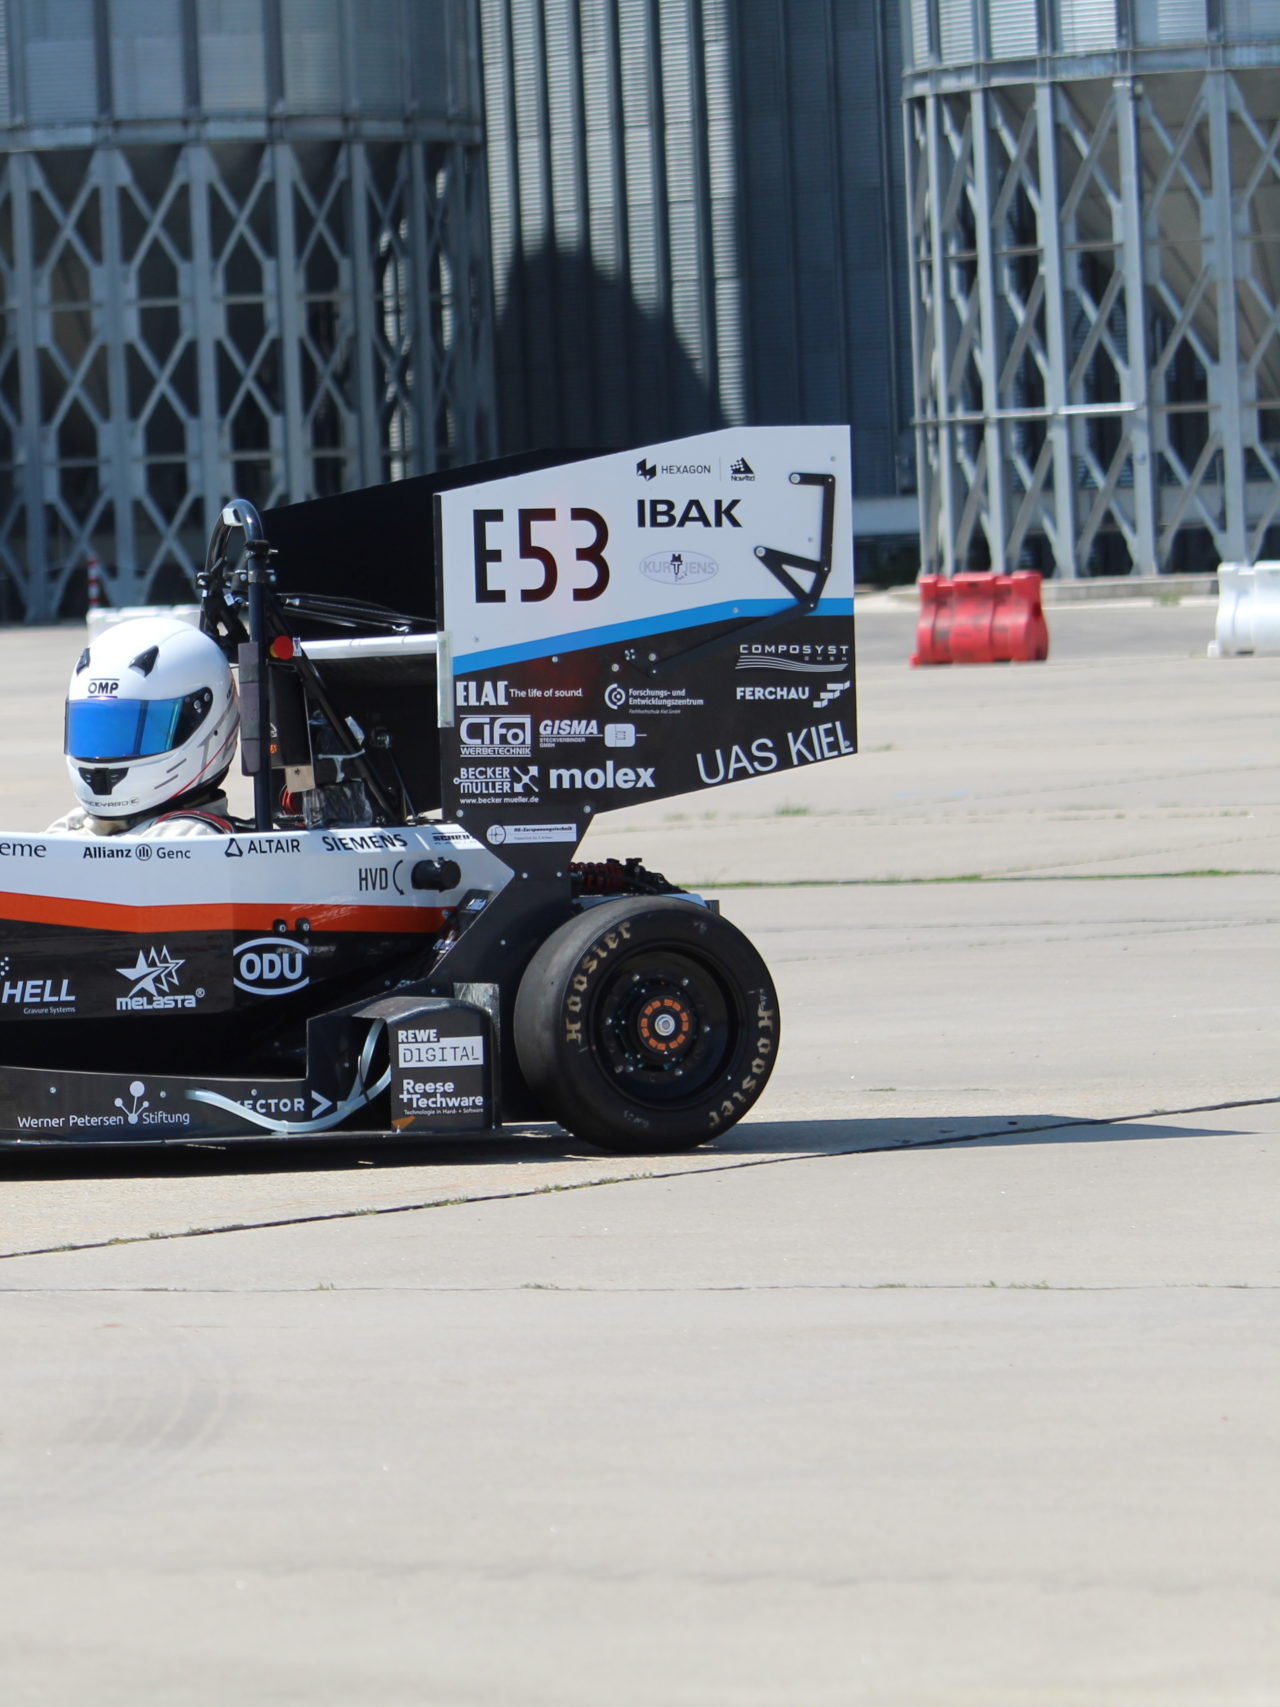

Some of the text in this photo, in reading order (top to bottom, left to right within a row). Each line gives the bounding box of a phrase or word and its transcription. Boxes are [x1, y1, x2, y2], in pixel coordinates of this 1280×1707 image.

[661, 465, 711, 475] HEXAGON
[637, 499, 742, 528] IBAK
[473, 507, 610, 604] E53
[739, 644, 849, 654] COMPOSYST
[88, 682, 119, 695] OMP
[456, 680, 508, 706] ELAC
[509, 688, 526, 698] The
[528, 688, 542, 698] life
[544, 688, 553, 697] of
[628, 688, 686, 698] Forschungs- und
[736, 687, 809, 700] FERCHAU
[628, 698, 704, 707] Entwicklungszentrum
[539, 720, 598, 735] GISMA
[460, 747, 532, 755] WERBETECHNIK
[696, 720, 854, 784] UAS KIEL
[460, 766, 511, 779] BECKER
[549, 760, 656, 790] molex
[247, 838, 301, 855] ALTAIR
[322, 834, 408, 852] SIEMENS
[83, 845, 191, 860] Allianz Genc
[358, 868, 388, 892] HVD
[240, 952, 303, 980] ODU
[566, 921, 631, 1044] Hoosier
[1, 978, 76, 1004] HELL
[50, 1006, 76, 1014] Systems
[398, 1029, 438, 1042] REWE
[403, 1045, 480, 1063] DIGITAL
[708, 1008, 774, 1128] Hoosier
[402, 1079, 455, 1094] Reese
[236, 1098, 305, 1113] ECTOR
[411, 1093, 484, 1108] Techware
[18, 1112, 190, 1128] Werner Petersen Stiftung
